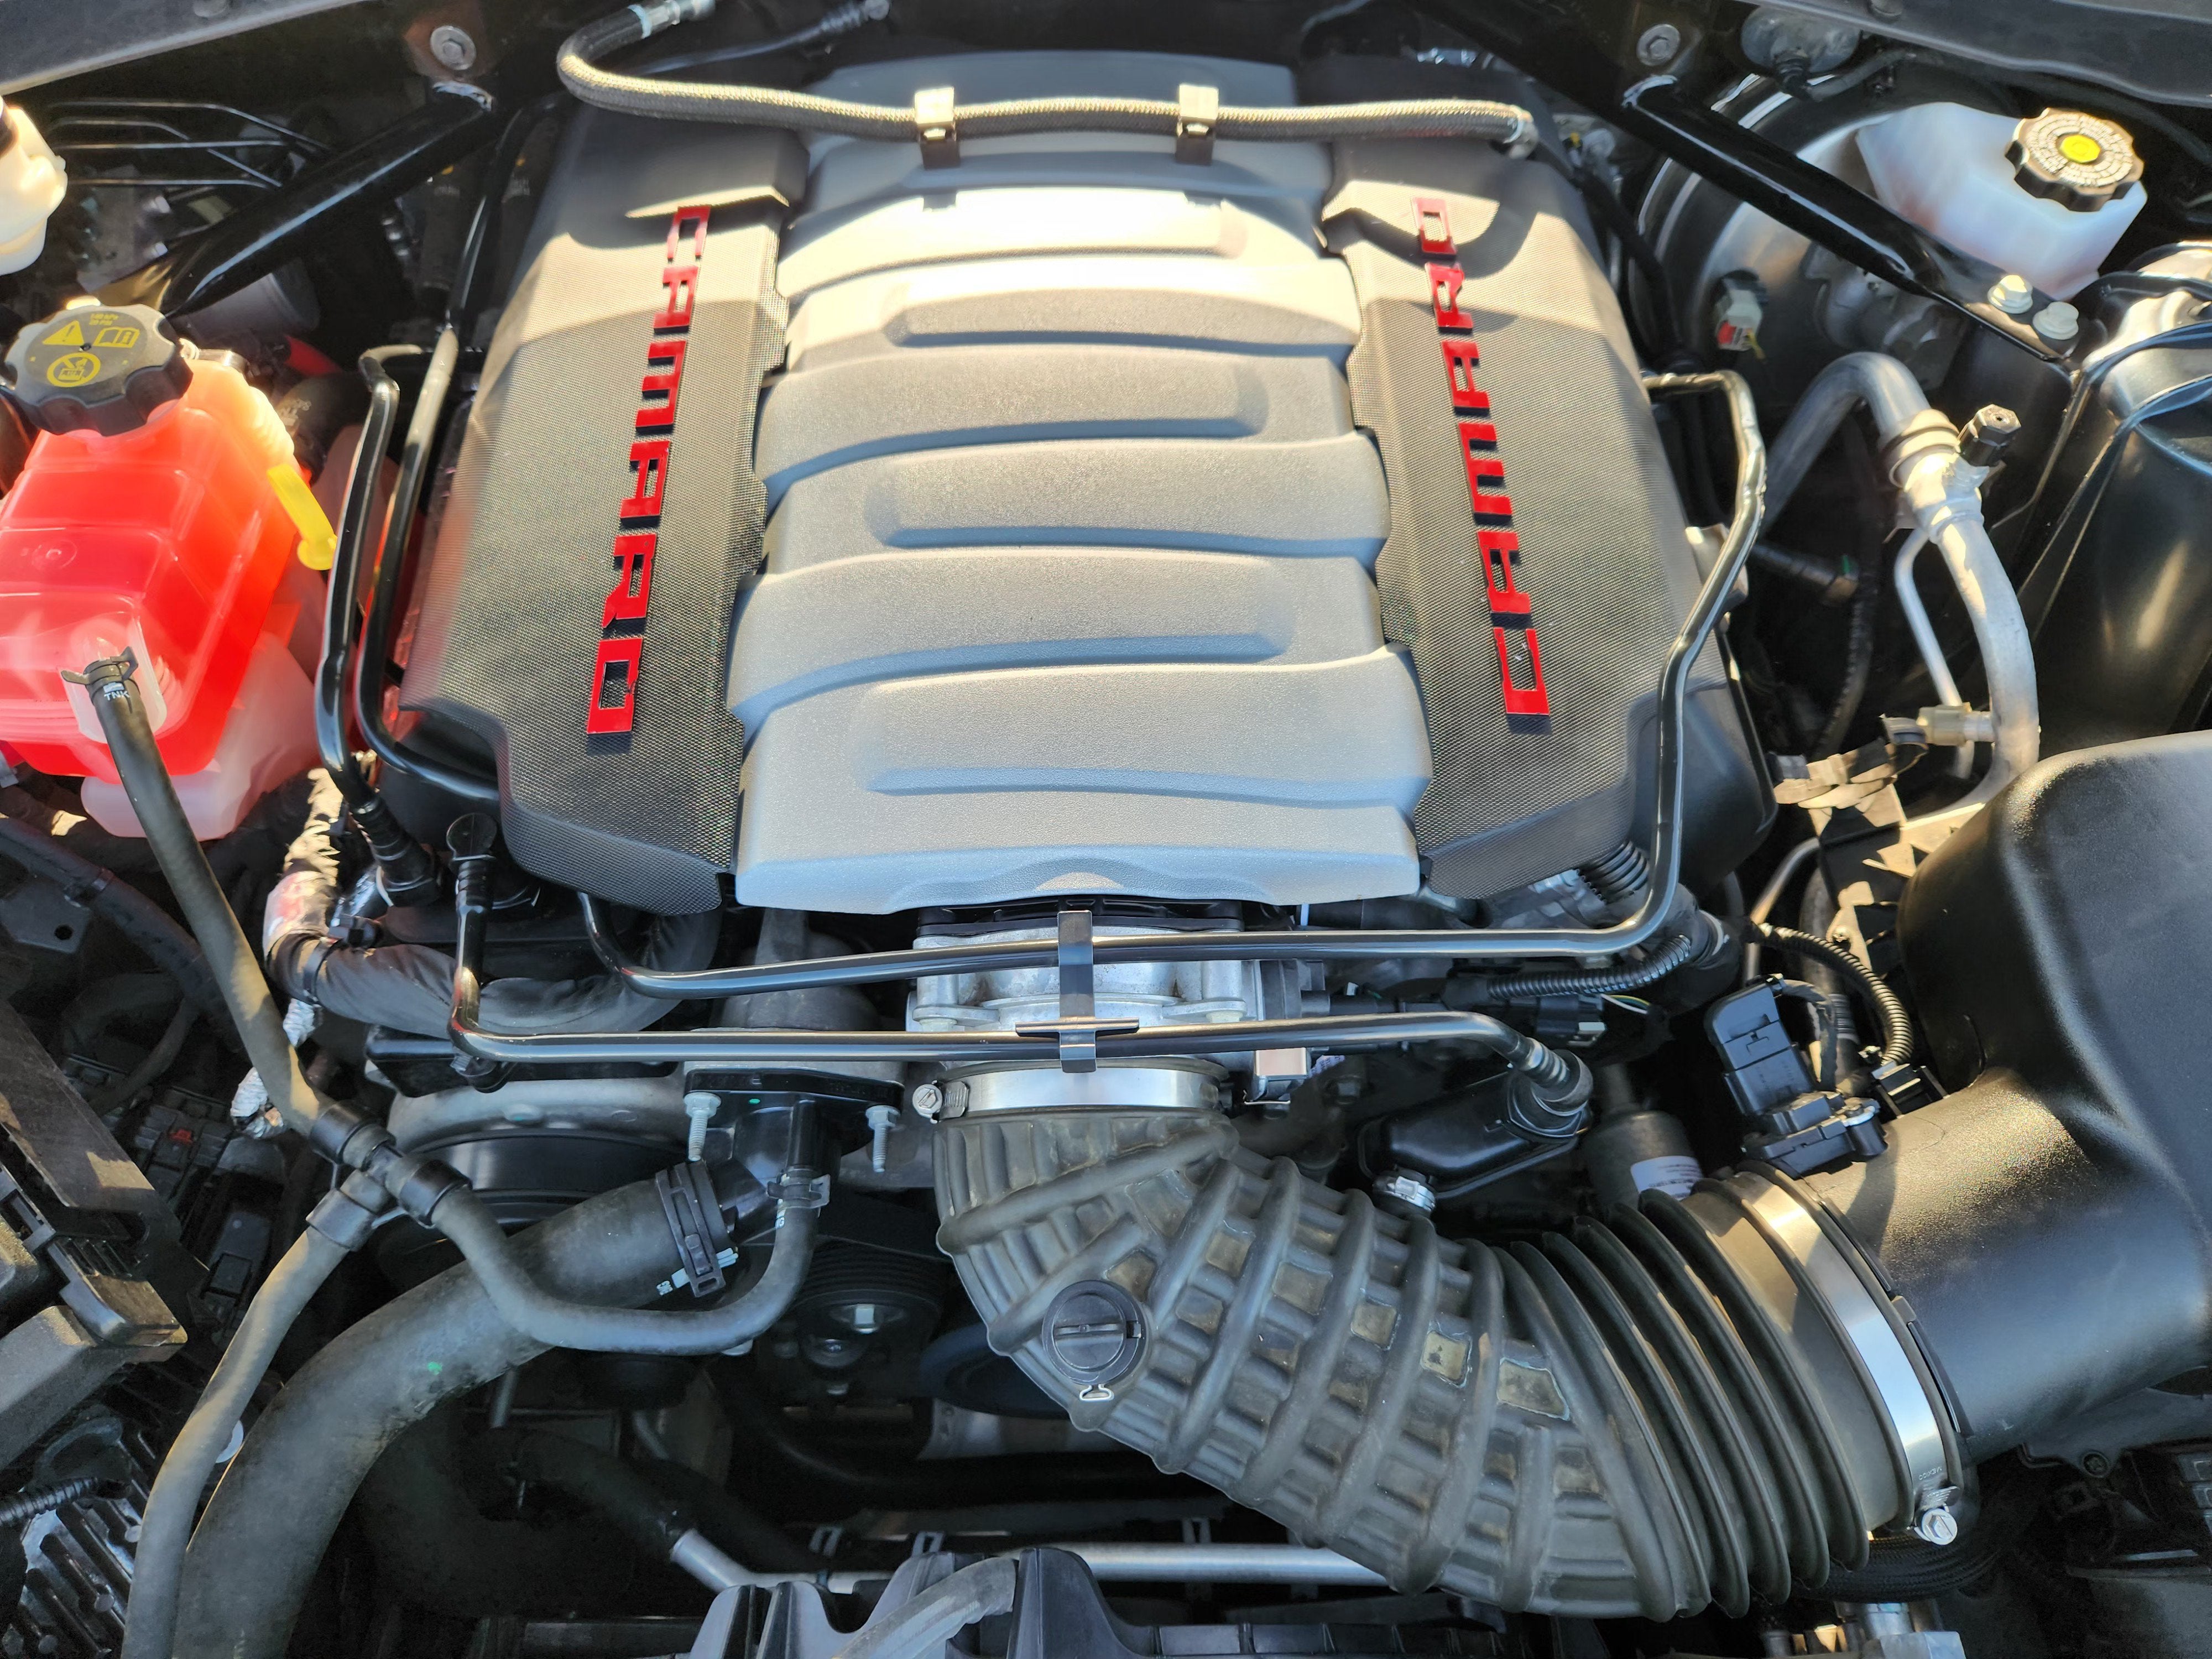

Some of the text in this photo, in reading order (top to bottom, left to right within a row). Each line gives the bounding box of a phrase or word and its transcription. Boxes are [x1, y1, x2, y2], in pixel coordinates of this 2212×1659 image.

[586, 205, 711, 734] CAMARO
[1411, 197, 1550, 714] CAMARO
[103, 690, 130, 701] TNK
[1919, 1466, 1942, 1480] MEXICO
